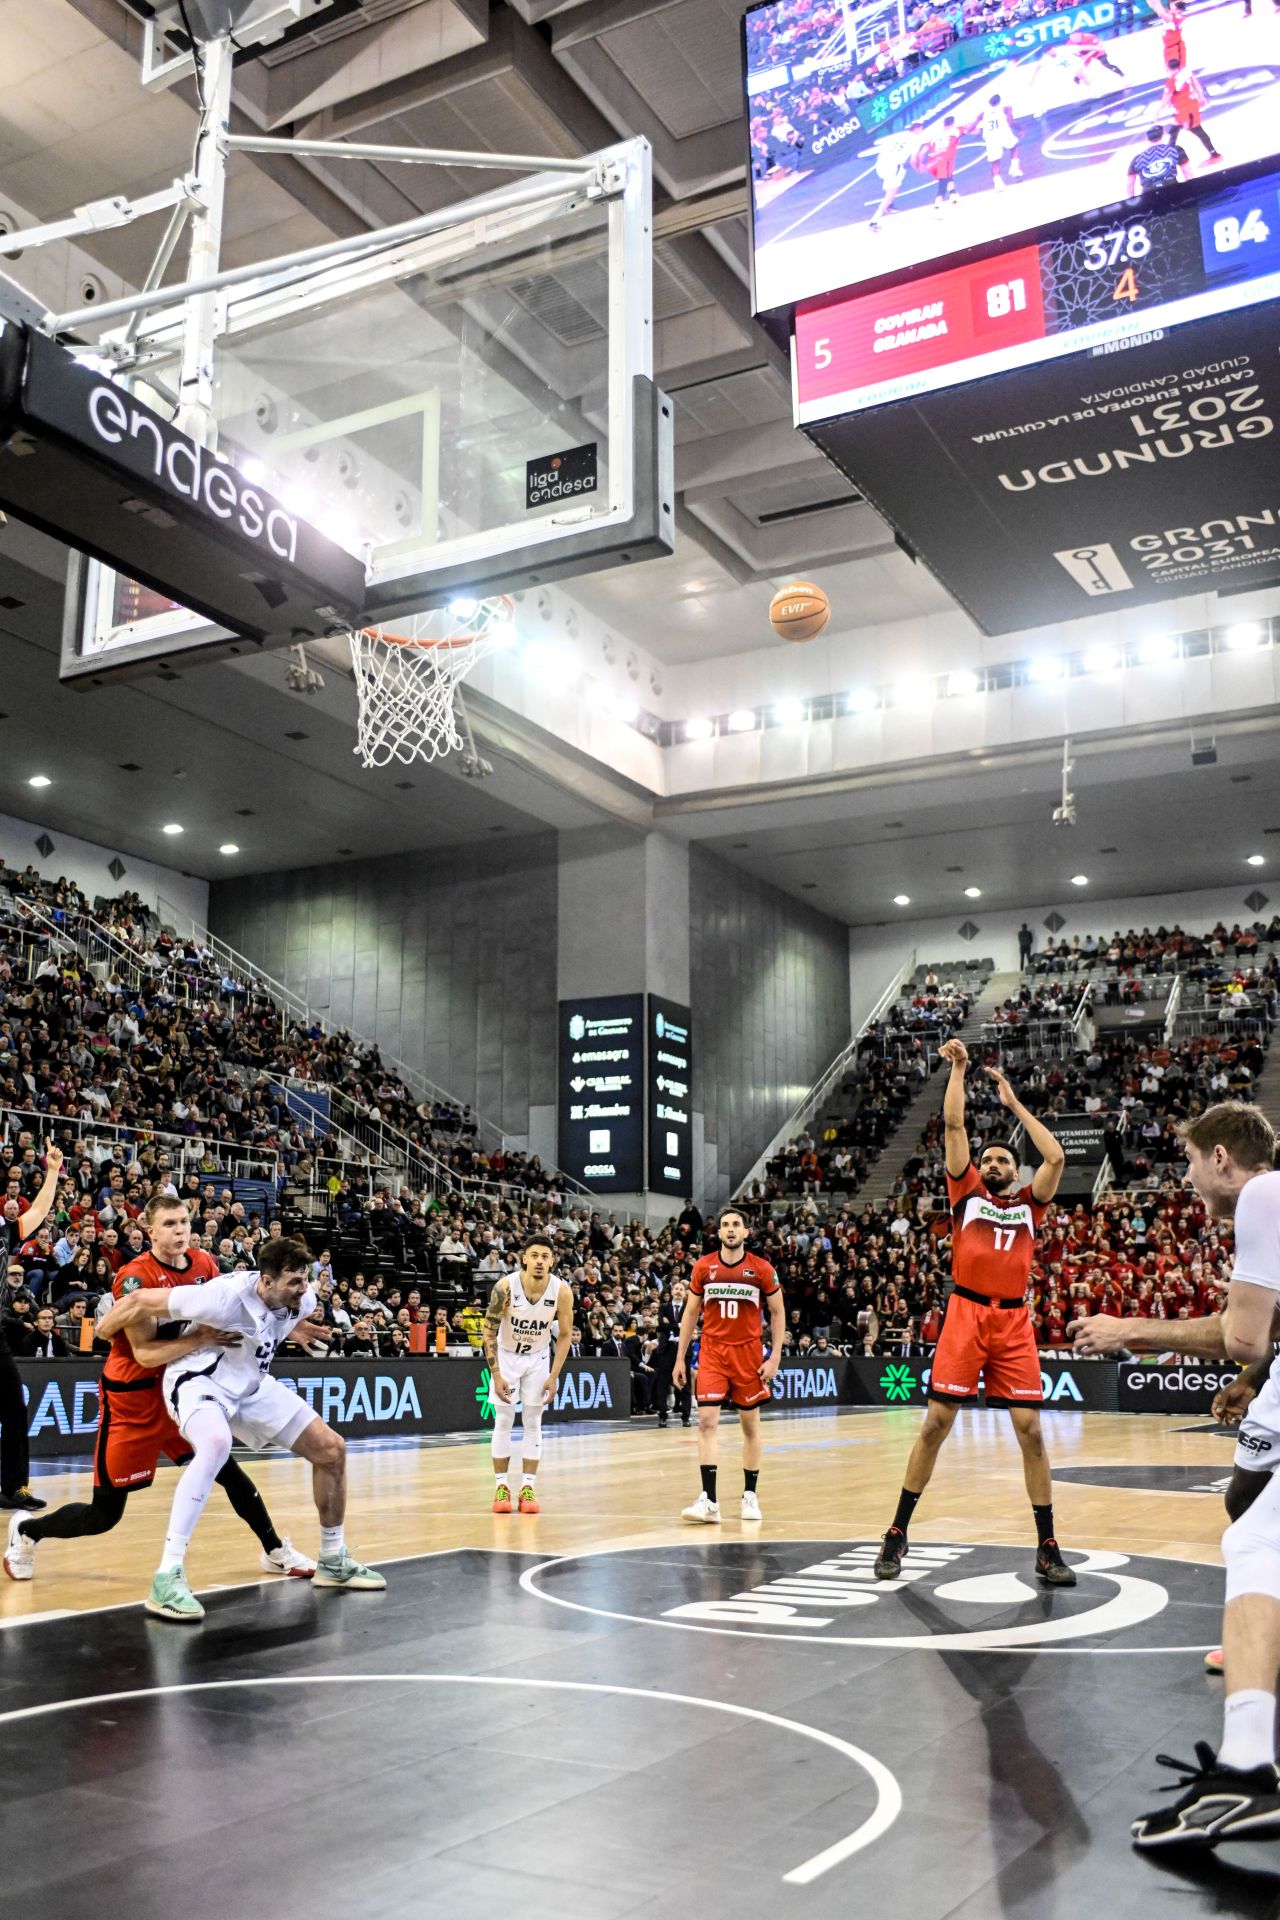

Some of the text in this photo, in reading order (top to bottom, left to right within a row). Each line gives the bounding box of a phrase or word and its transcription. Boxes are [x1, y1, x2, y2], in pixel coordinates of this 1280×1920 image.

[888, 58, 952, 110] STRADA
[812, 116, 861, 154] endesa
[1213, 208, 1270, 252] 84
[1083, 225, 1151, 271] 37.8
[986, 278, 1027, 318] 81
[1112, 267, 1139, 302] 4
[814, 338, 832, 369] 5
[1104, 328, 1164, 356] MONDO
[1081, 356, 1250, 404] CIUDAD CANDIDATA
[972, 369, 1254, 444] CAPITAL EUROPEA DE LA CULTURA
[1130, 385, 1265, 437] 2031
[89, 386, 298, 563] endesa
[529, 470, 559, 489] liga
[529, 475, 596, 503] endesa
[1129, 508, 1280, 551] GRAN
[1141, 534, 1255, 570] 2031
[1151, 562, 1209, 578] CAPITAL
[1155, 570, 1208, 584] CIUDAD
[993, 1226, 1017, 1252] 17
[510, 1316, 550, 1331] UCAM
[718, 1300, 739, 1320] 10
[512, 1327, 543, 1337] MURCIA
[514, 1342, 533, 1355] 12
[772, 1367, 838, 1400] STRADA
